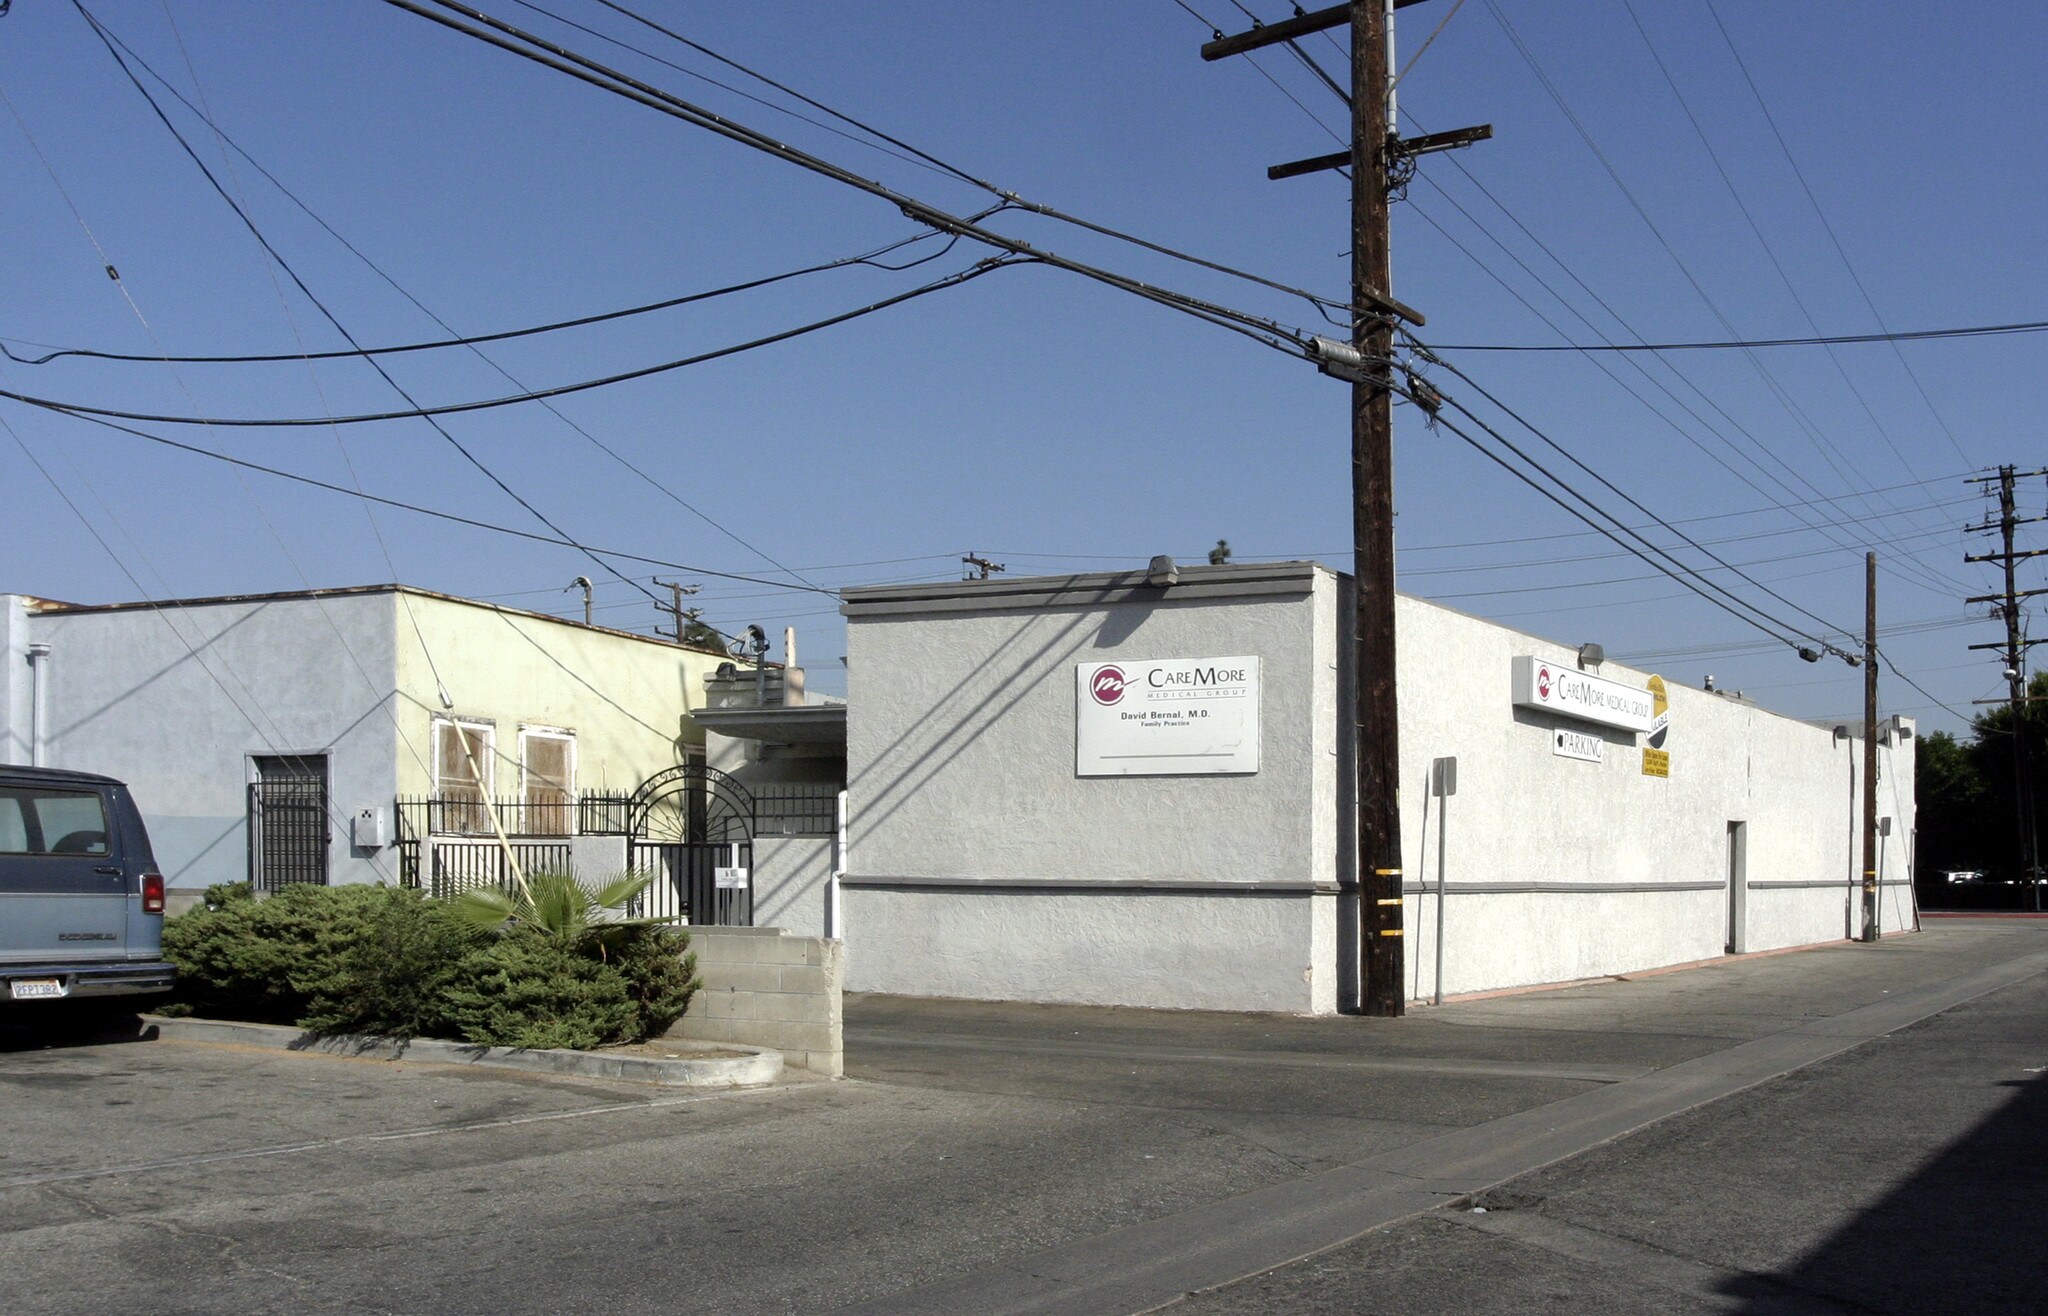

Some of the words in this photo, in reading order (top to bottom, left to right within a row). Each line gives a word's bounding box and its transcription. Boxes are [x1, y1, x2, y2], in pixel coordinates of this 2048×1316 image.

[1206, 689, 1247, 697] GROUP
[1606, 695, 1630, 713] MEDICAL
[1631, 701, 1649, 717] GROUP
[1121, 711, 1147, 720] David
[1150, 710, 1184, 720] Bernal,
[1188, 709, 1211, 718] M.D.
[1563, 732, 1602, 758] PARKING
